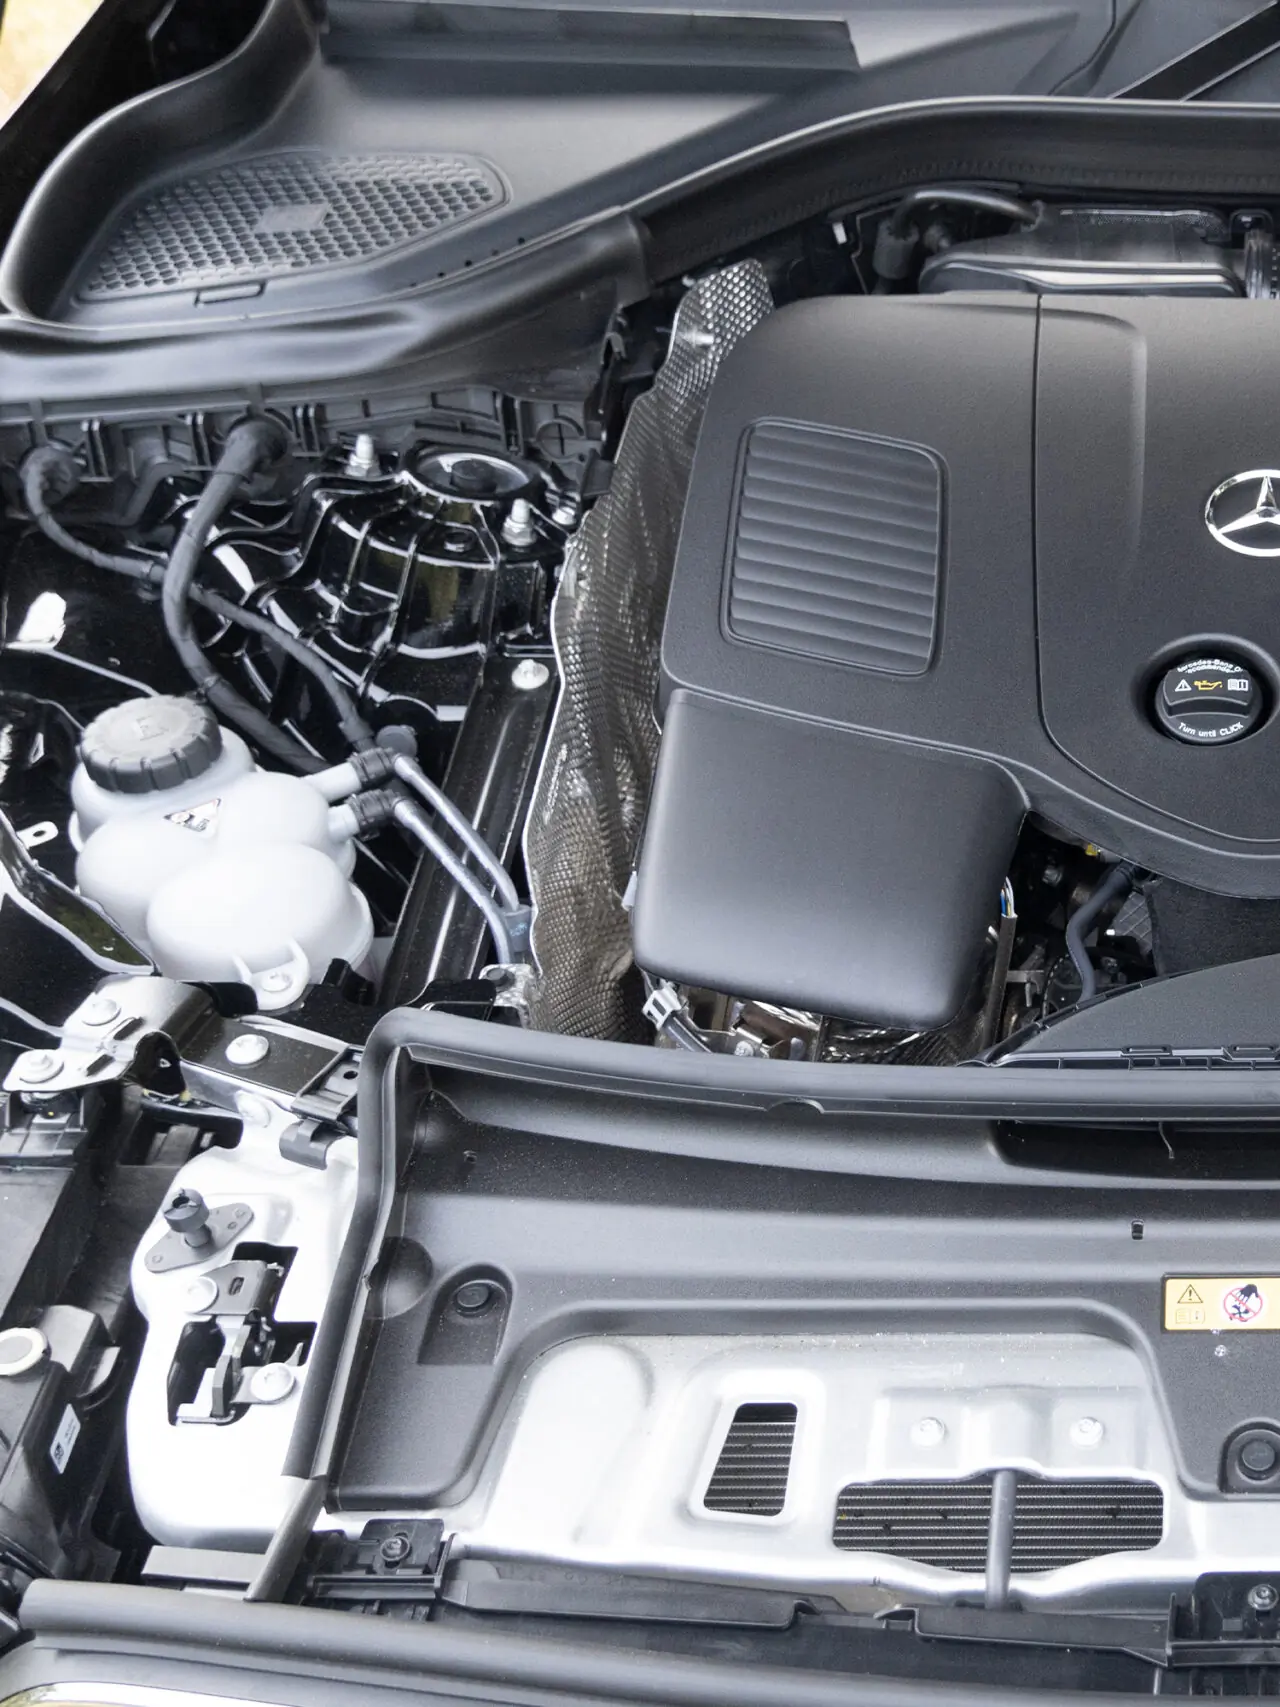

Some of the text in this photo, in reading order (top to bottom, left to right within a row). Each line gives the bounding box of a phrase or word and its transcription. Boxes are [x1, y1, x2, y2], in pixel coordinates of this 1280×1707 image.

[1185, 665, 1235, 674] ecommende
[1179, 722, 1196, 735] Turn
[1219, 721, 1244, 736] CLICK
